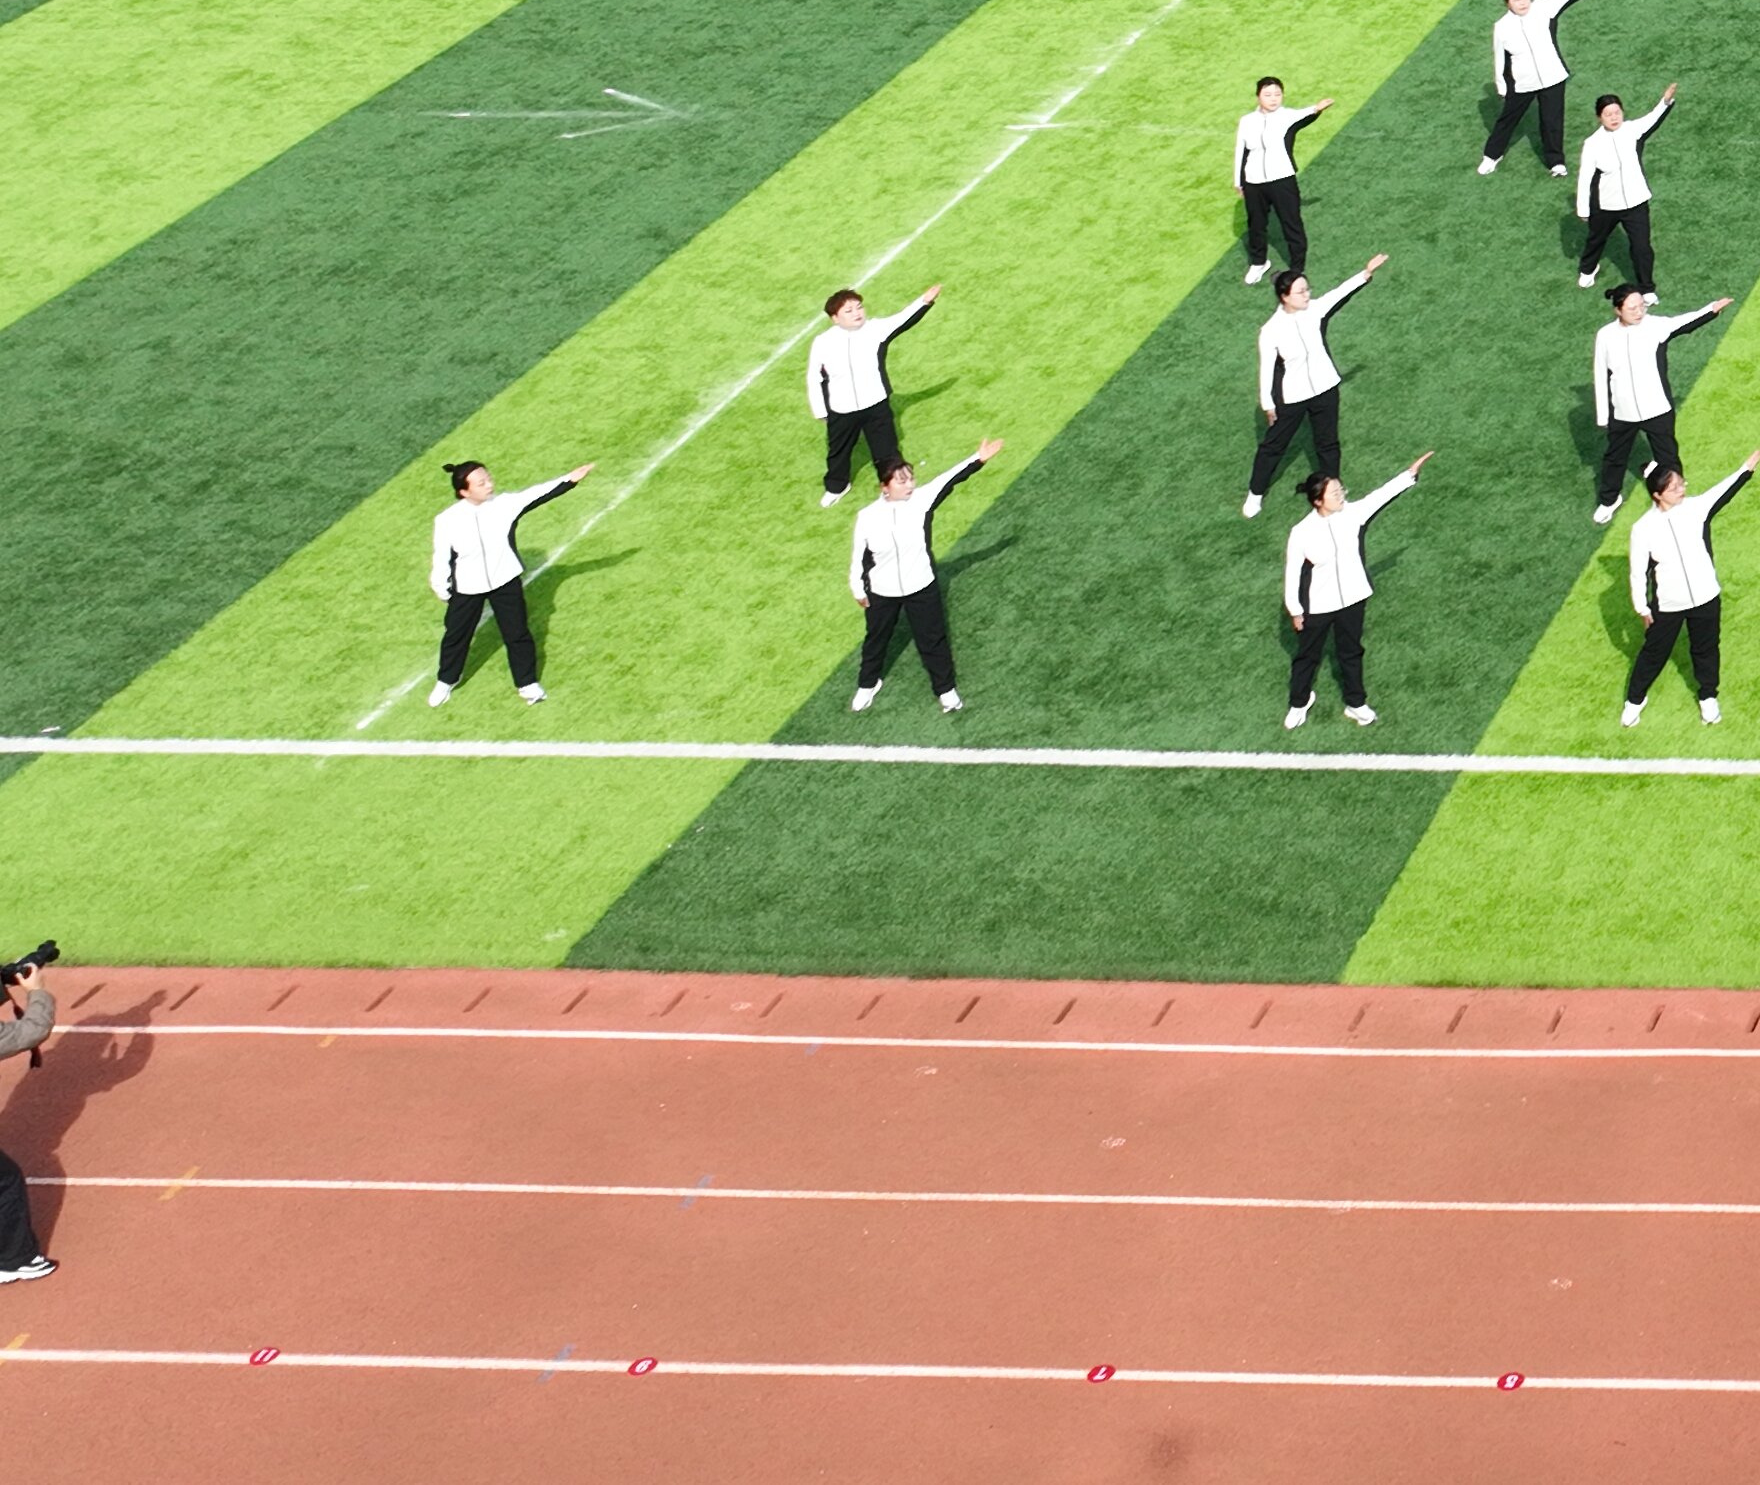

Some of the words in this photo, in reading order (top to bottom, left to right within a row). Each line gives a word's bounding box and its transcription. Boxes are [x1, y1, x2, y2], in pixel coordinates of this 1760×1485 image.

[254, 1349, 277, 1362] 11
[1093, 1366, 1107, 1381] 7
[1504, 1374, 1519, 1389] 5
